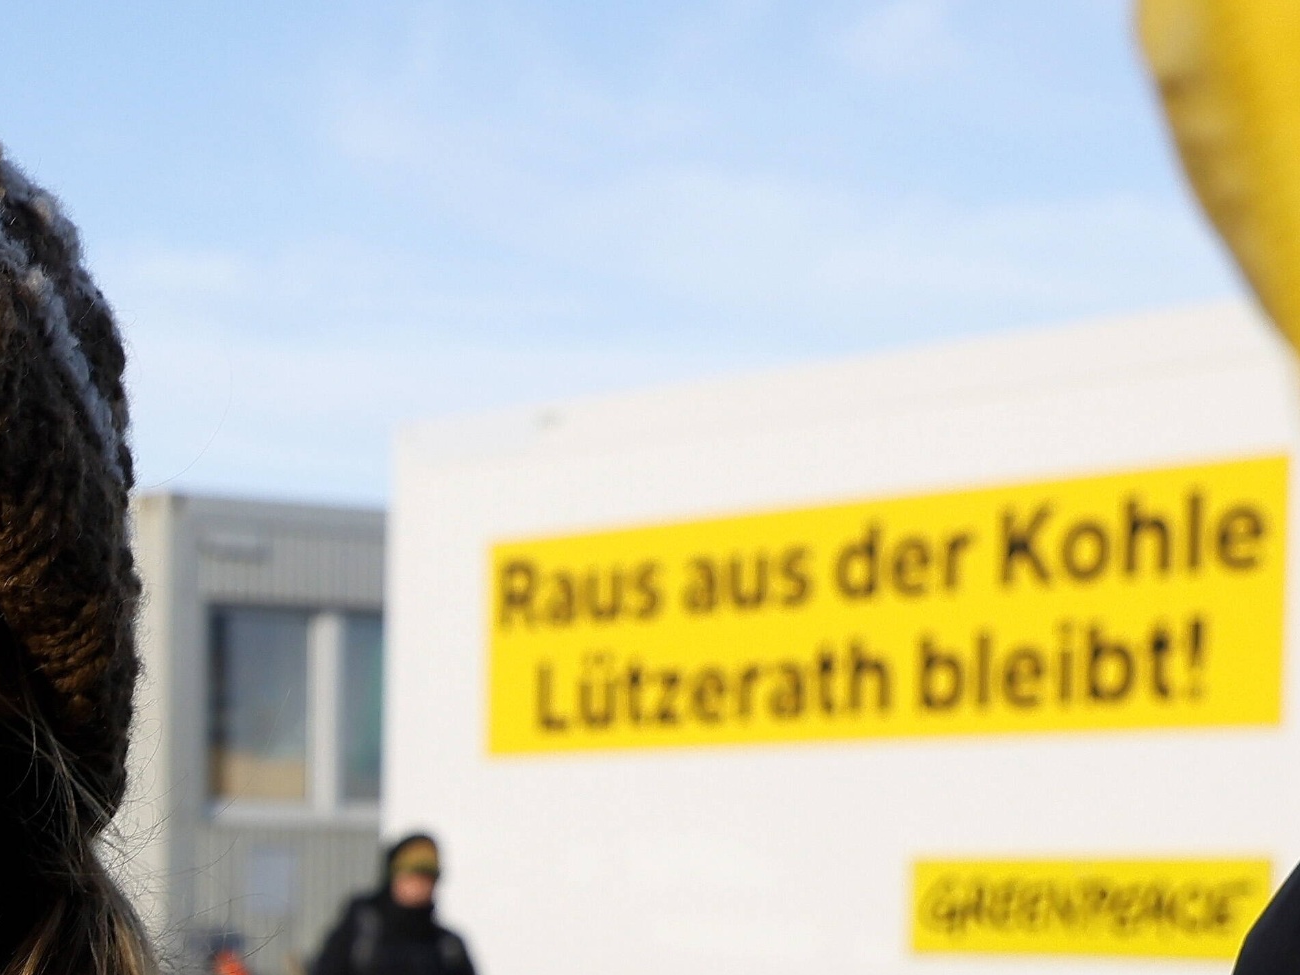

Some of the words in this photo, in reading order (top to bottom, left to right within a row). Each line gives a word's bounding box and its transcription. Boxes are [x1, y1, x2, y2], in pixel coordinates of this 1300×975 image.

[499, 557, 662, 630] Raus
[682, 545, 811, 617] aus
[834, 520, 972, 600] der
[998, 488, 1265, 588] Kohle
[536, 640, 892, 734] Lützerath
[919, 616, 1208, 714] bleibt!
